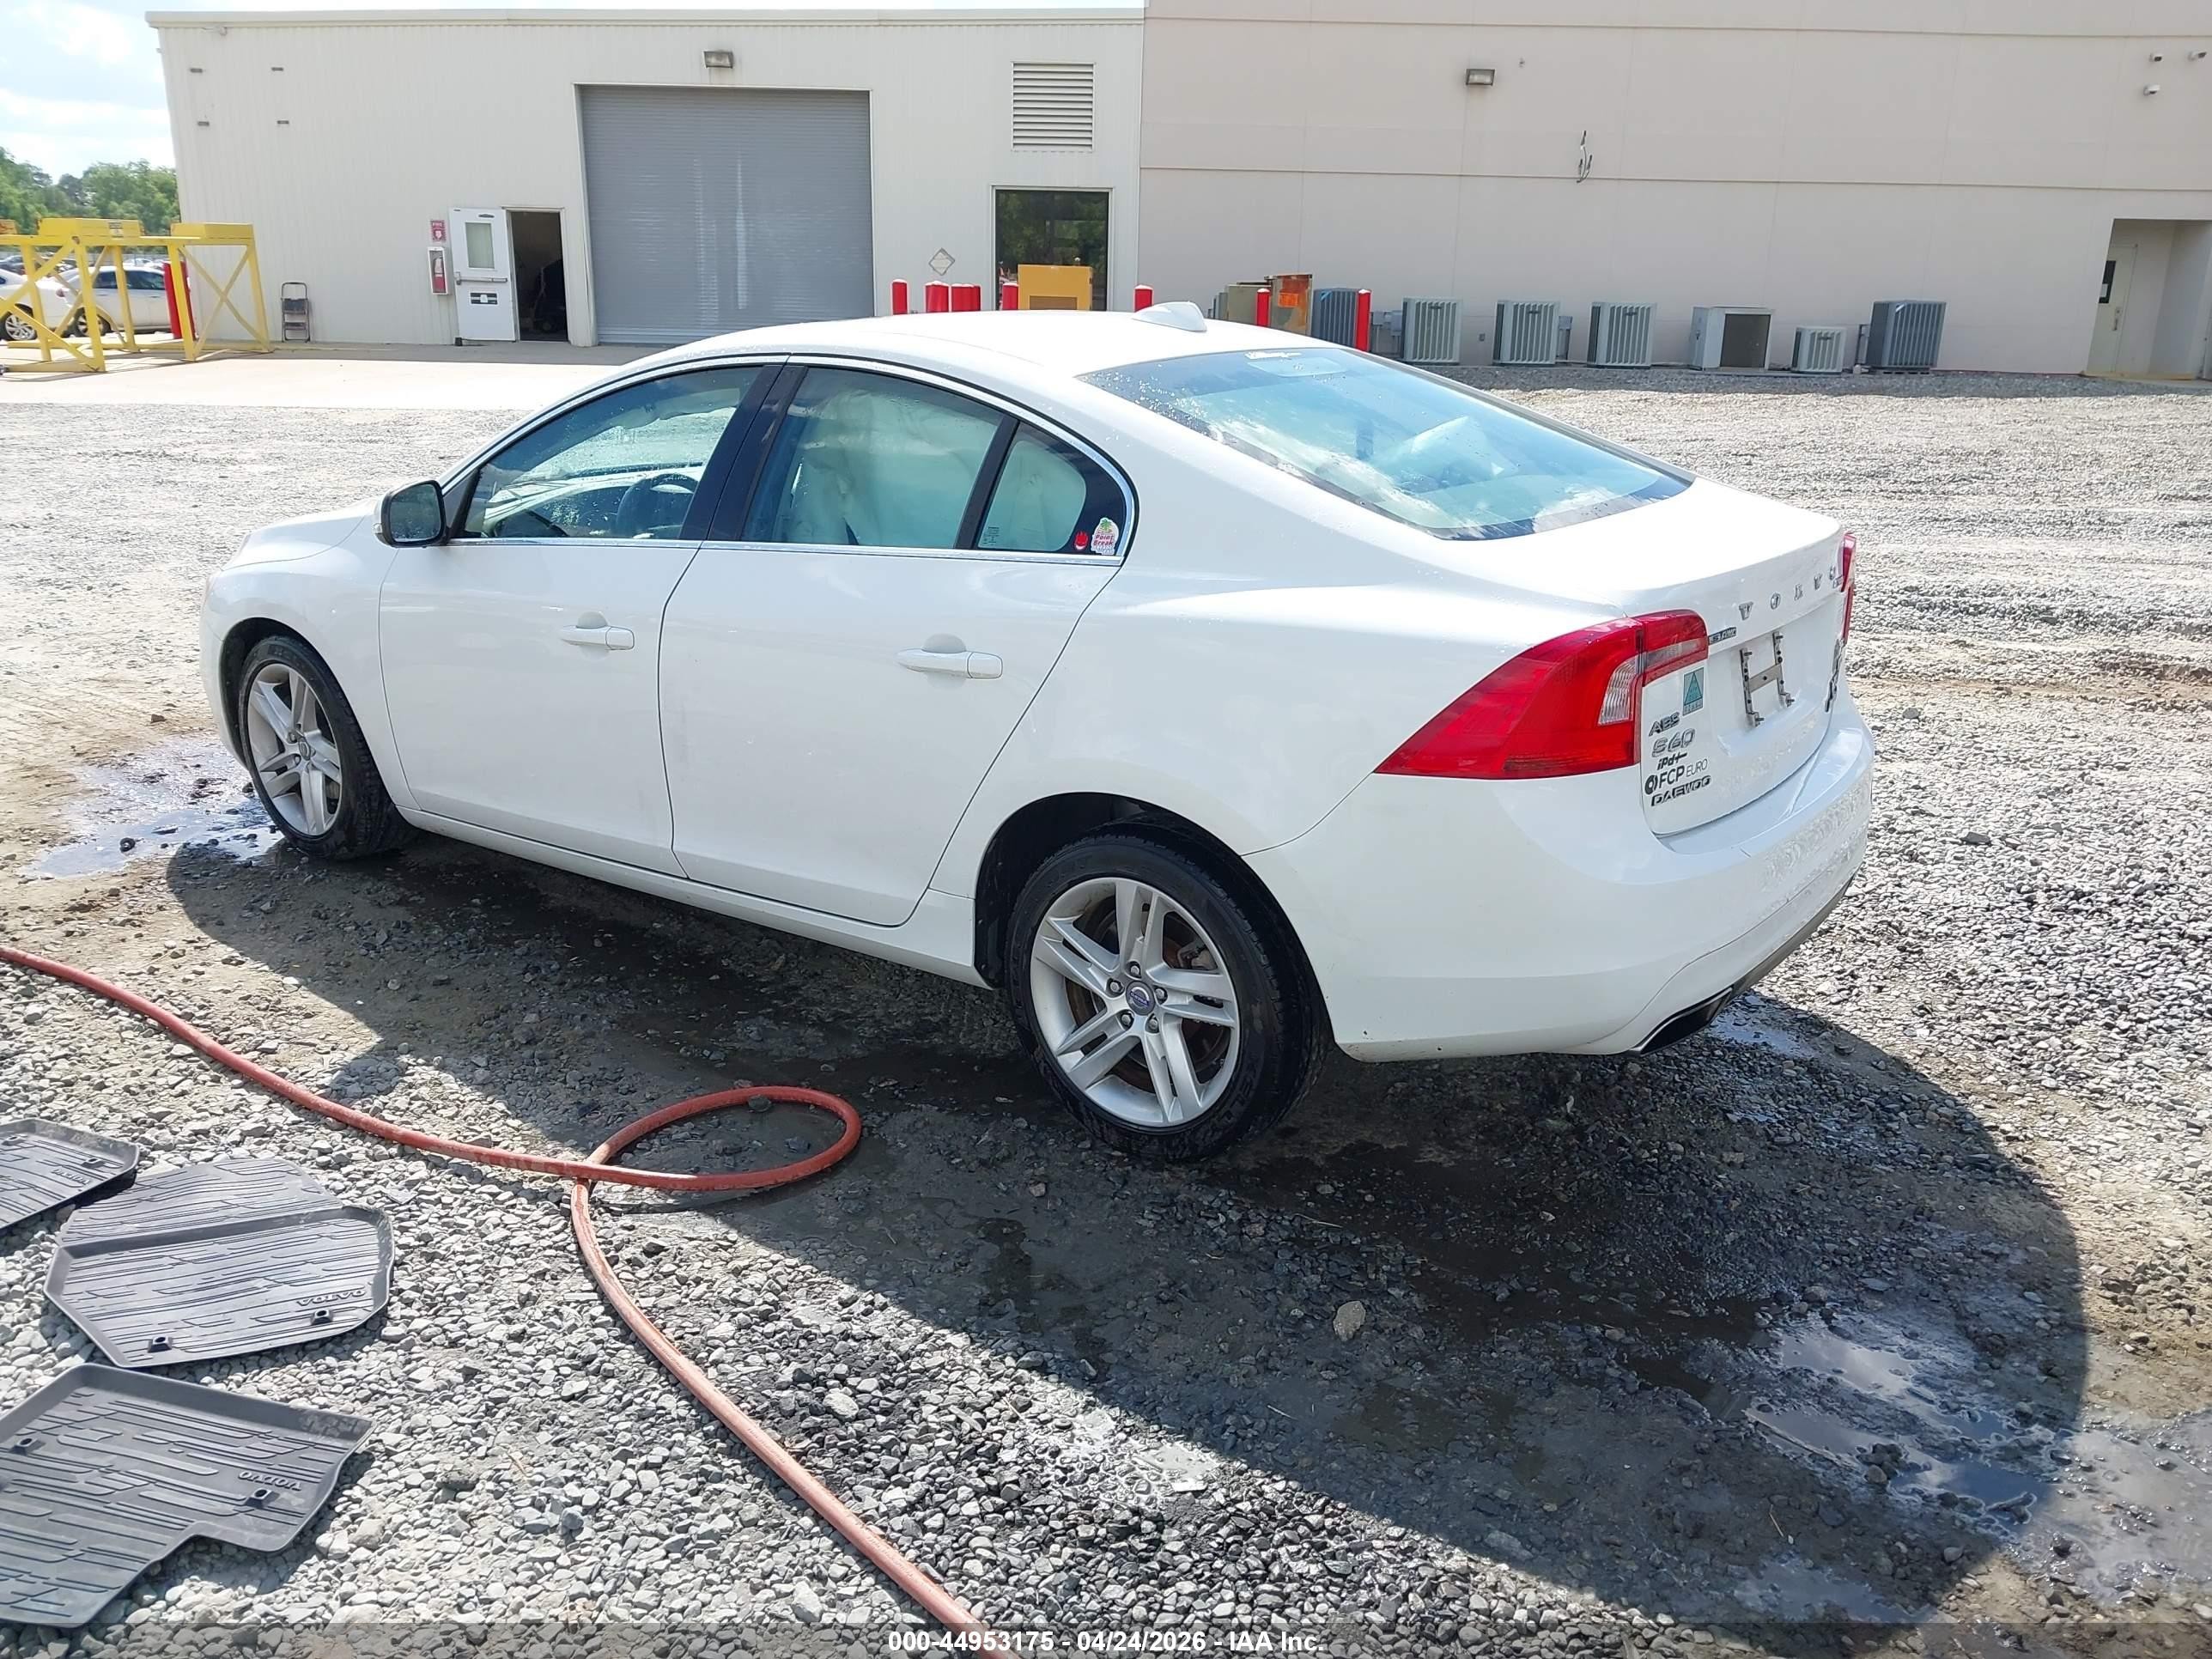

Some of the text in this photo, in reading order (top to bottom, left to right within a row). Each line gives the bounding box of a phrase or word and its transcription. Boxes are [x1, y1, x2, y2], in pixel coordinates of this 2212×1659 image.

[1651, 728, 1695, 757] S60
[1650, 775, 1711, 807] DAEWOO
[296, 1289, 367, 1306] VOLVO
[237, 1470, 302, 1492] VOLVO
